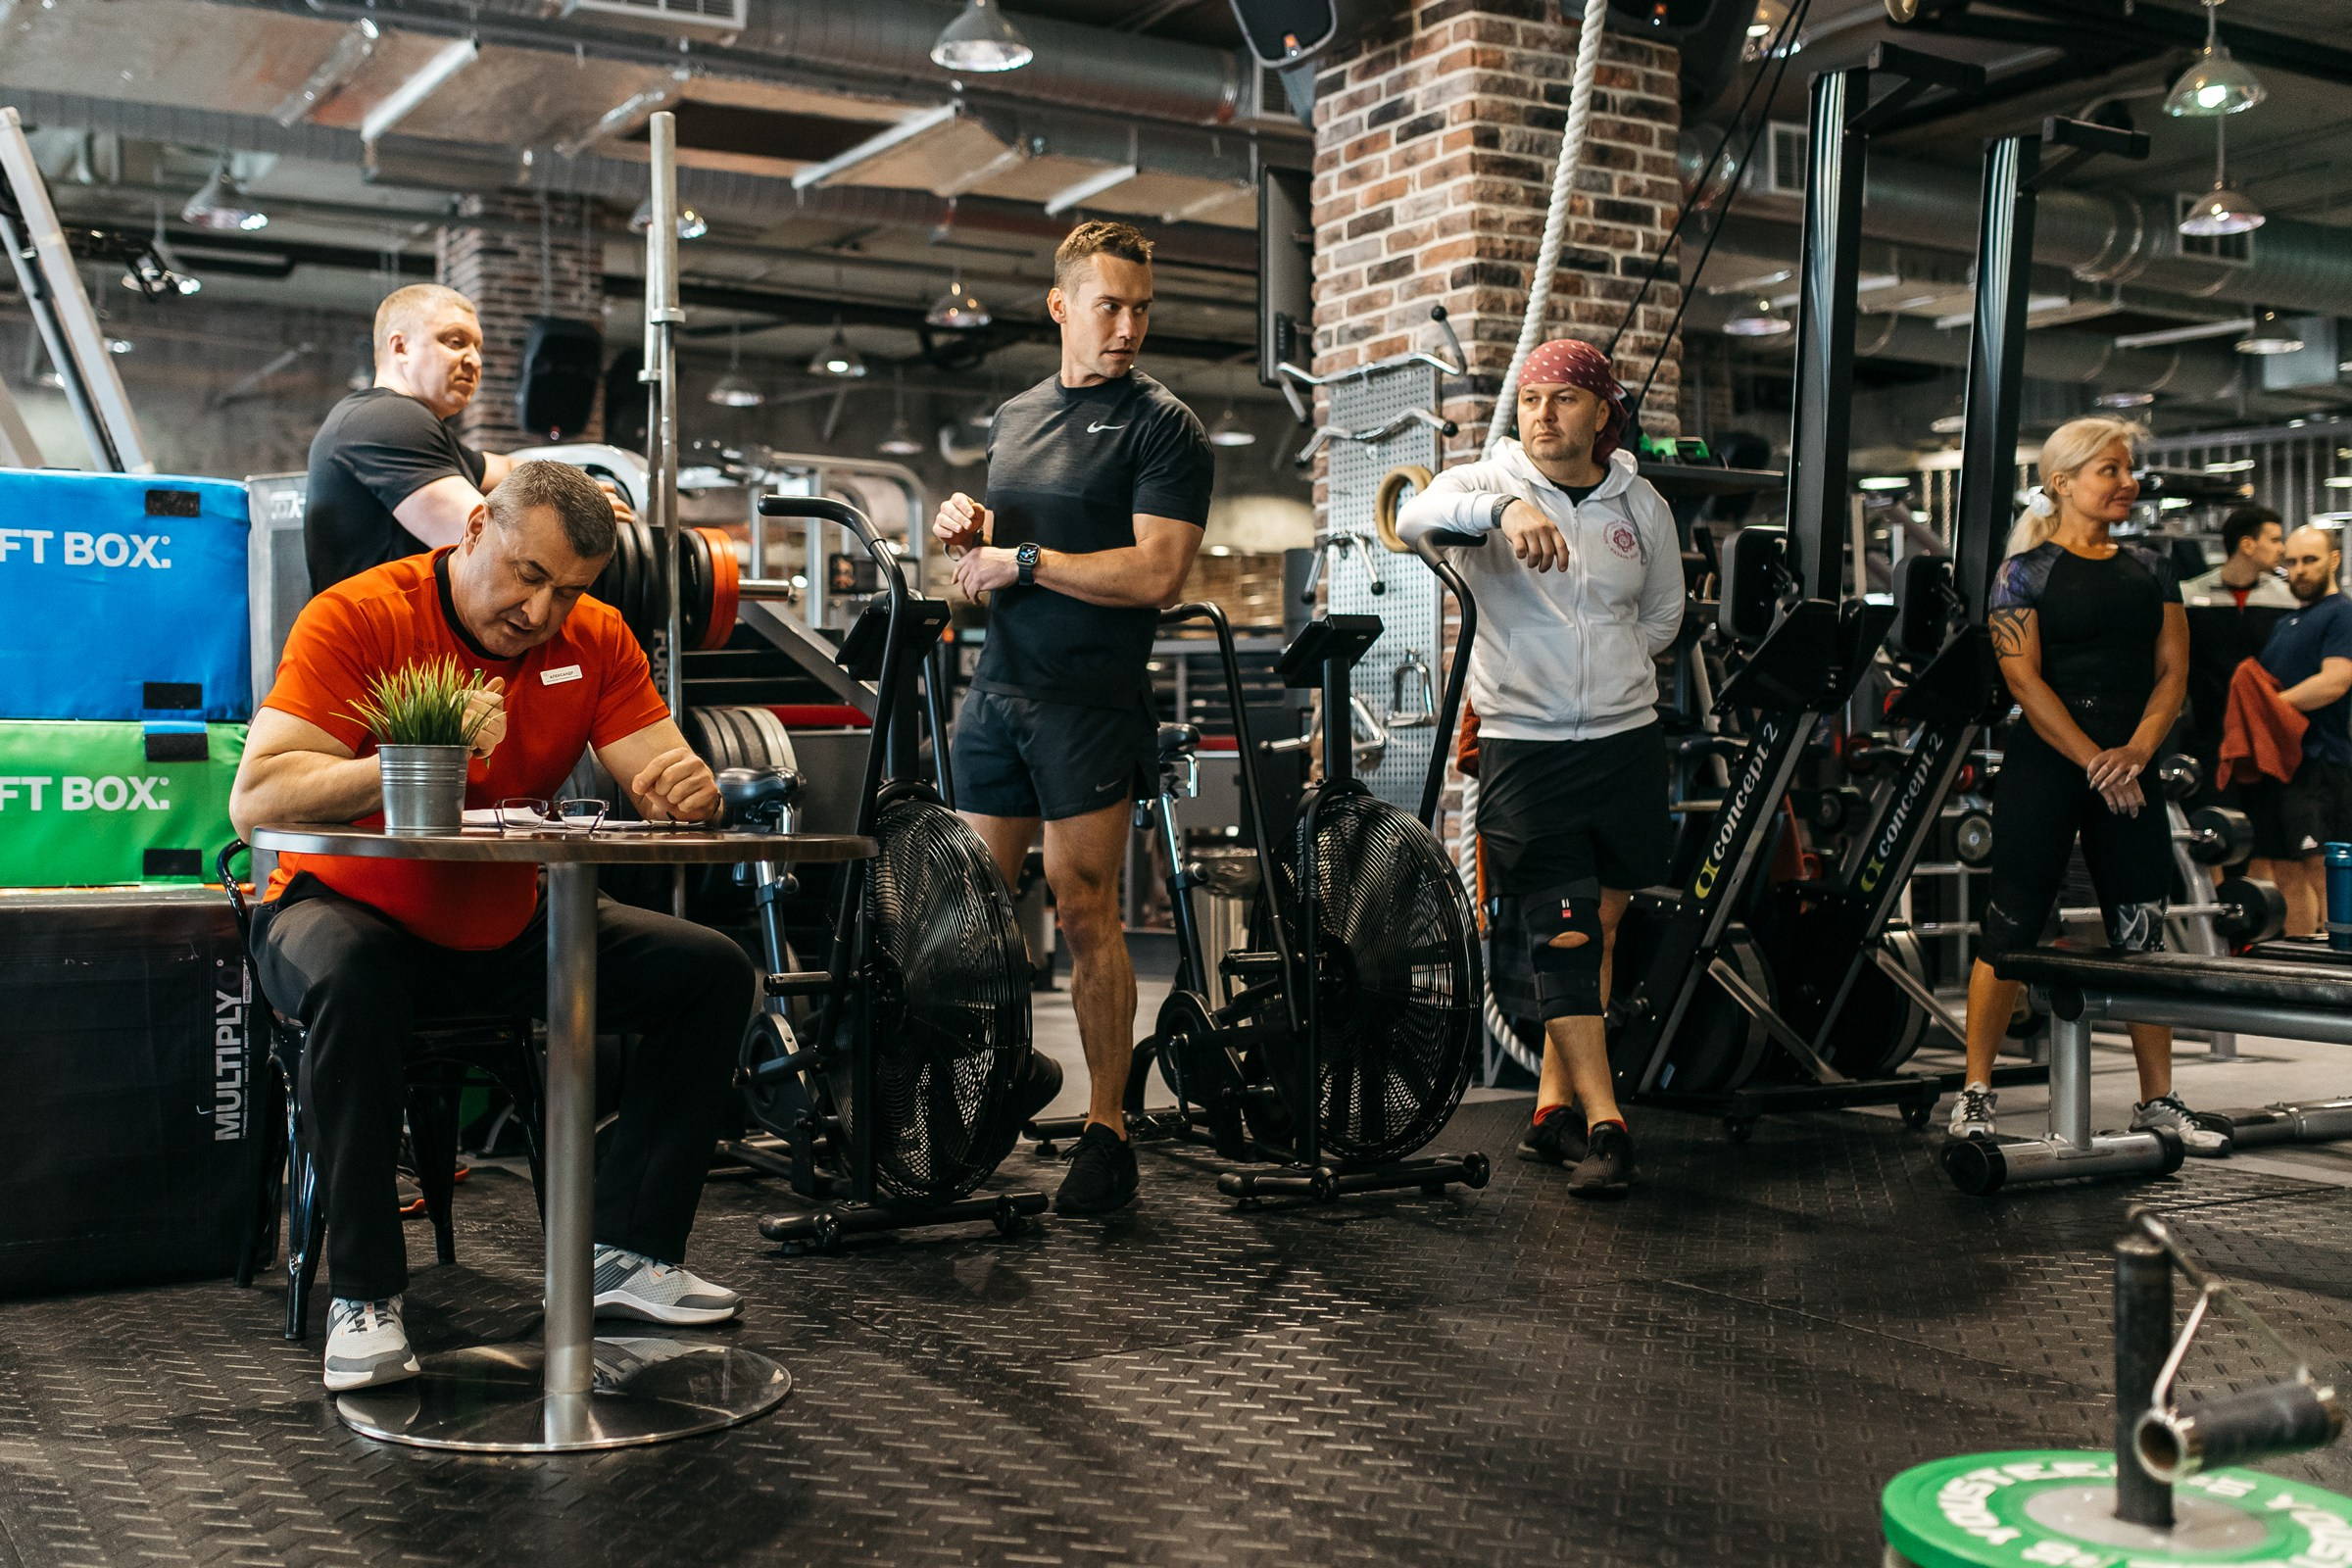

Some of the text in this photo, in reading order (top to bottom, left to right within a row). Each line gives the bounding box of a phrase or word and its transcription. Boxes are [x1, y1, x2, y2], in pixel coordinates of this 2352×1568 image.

[1713, 721, 1779, 861] concept 2
[1879, 732, 1943, 858] concept 2
[215, 990, 242, 1142] MULTIPLY
